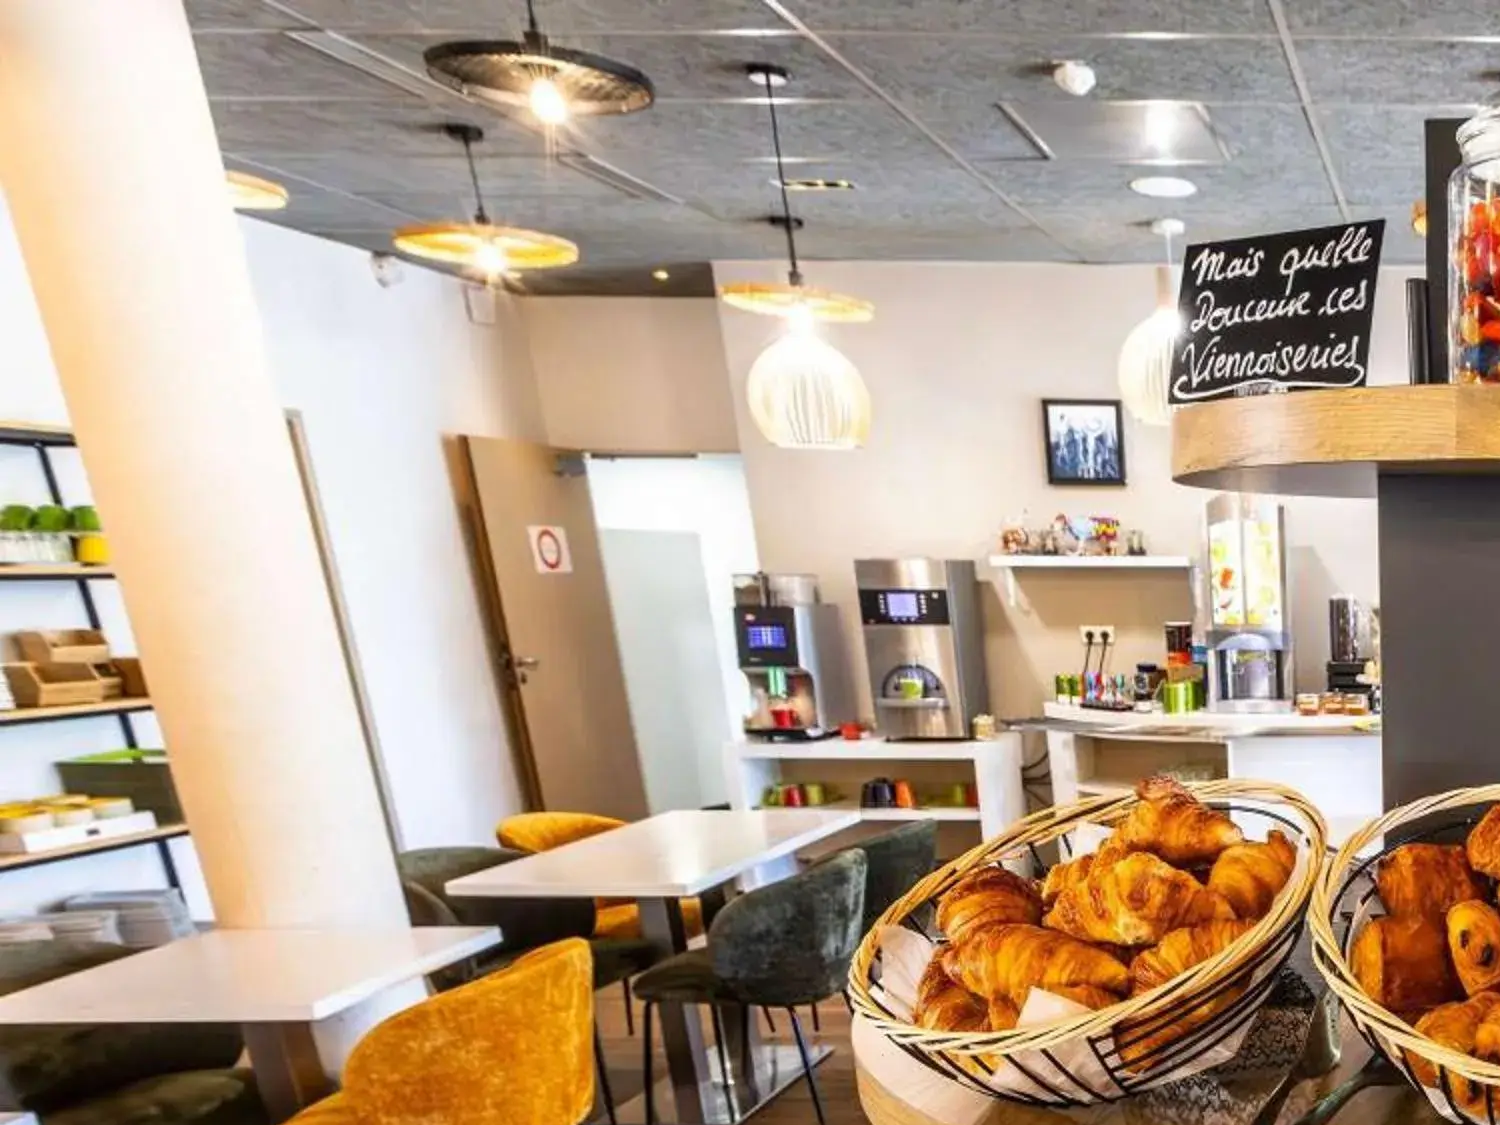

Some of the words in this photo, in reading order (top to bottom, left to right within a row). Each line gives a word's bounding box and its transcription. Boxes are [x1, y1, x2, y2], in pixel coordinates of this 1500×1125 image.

[1192, 247, 1264, 286] Mais
[1280, 225, 1373, 296] quelle
[1181, 333, 1362, 390] Viennoiseries
